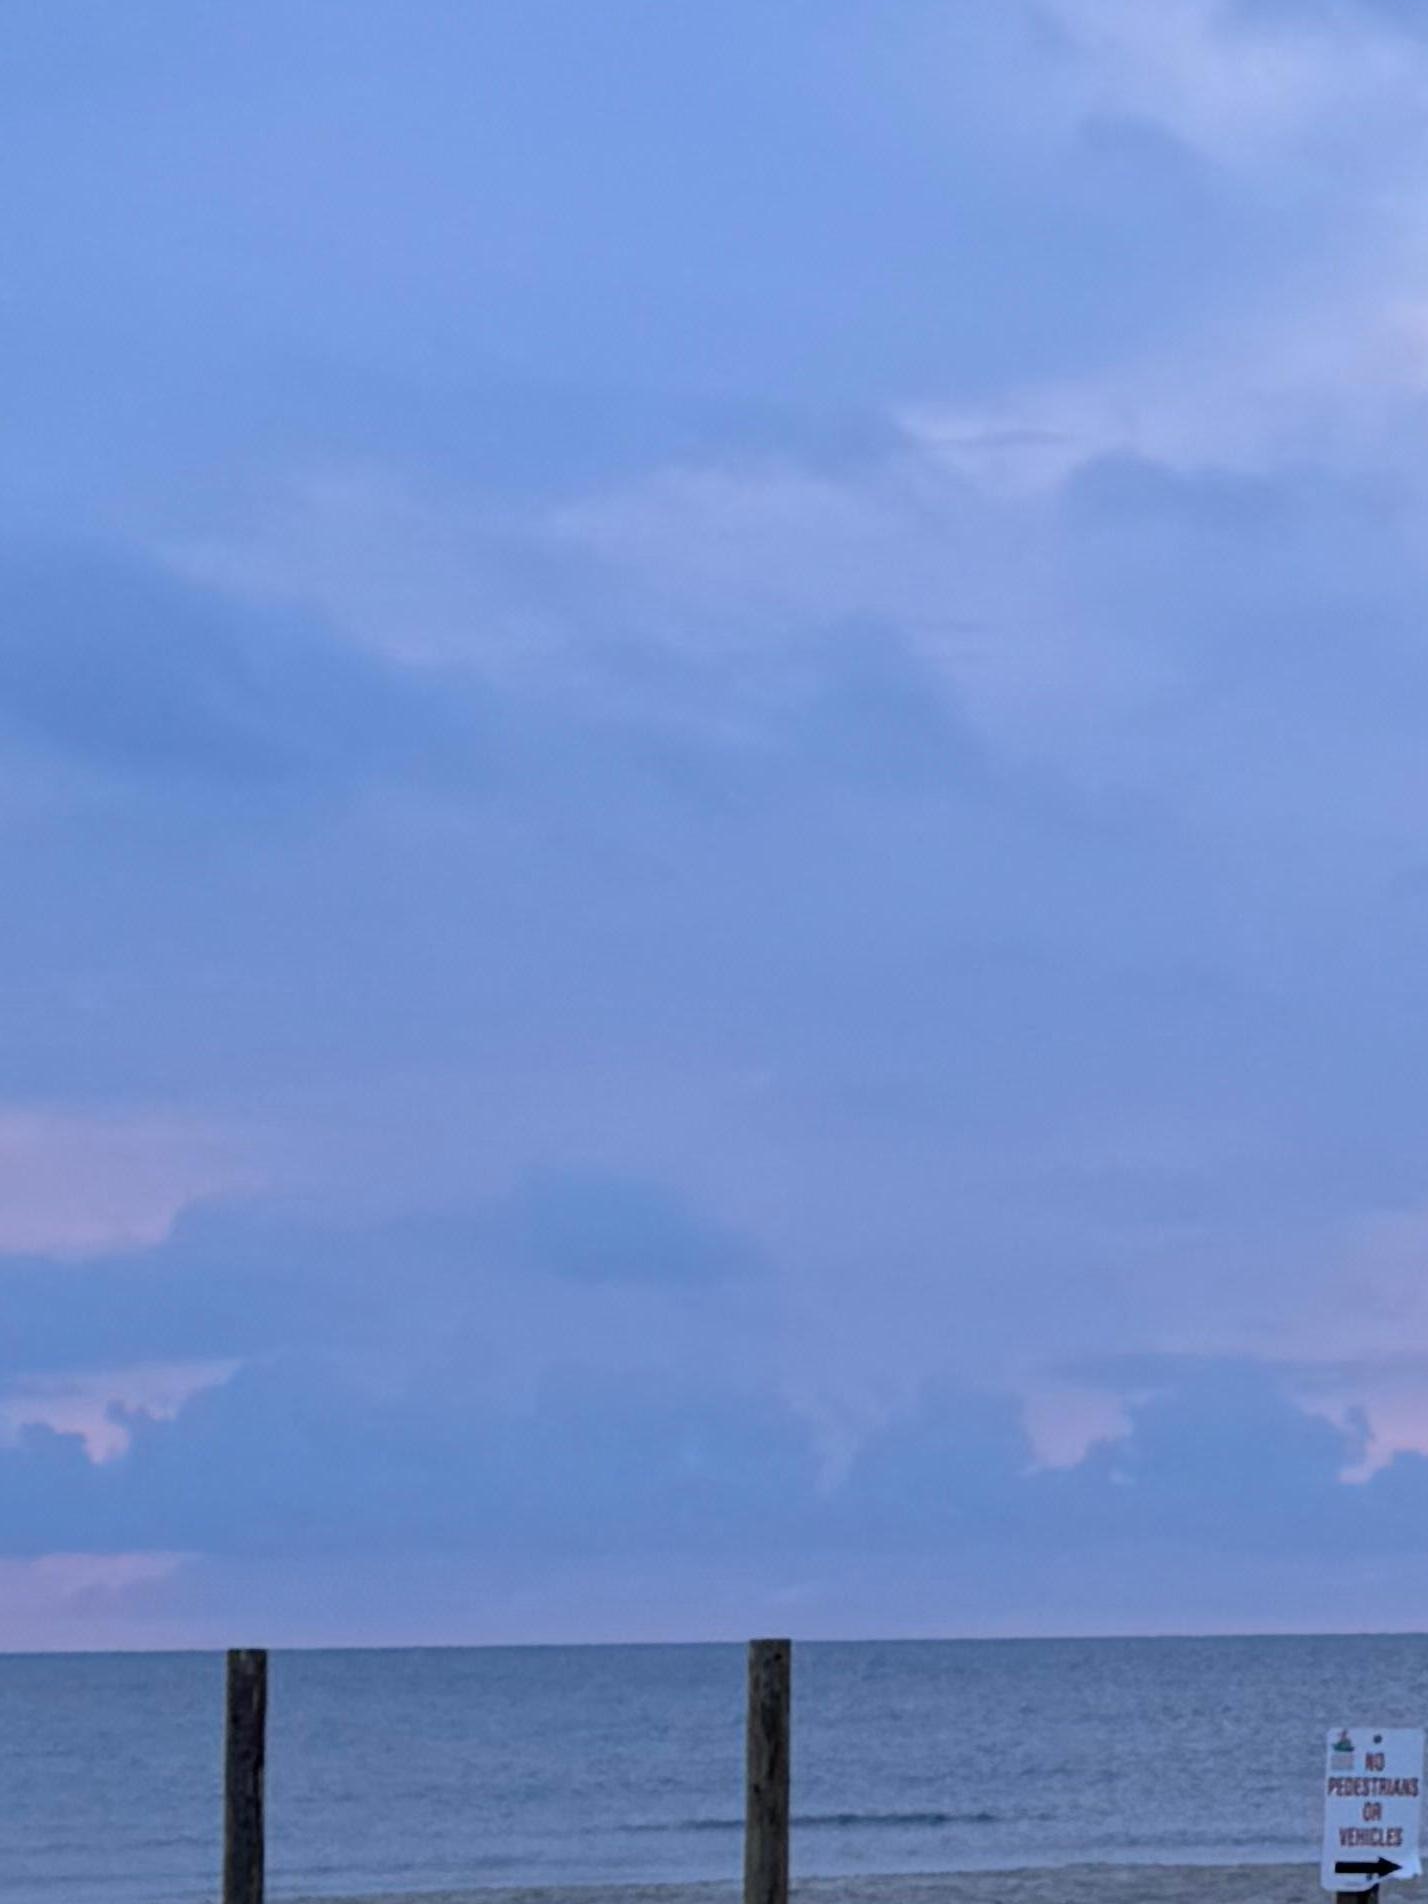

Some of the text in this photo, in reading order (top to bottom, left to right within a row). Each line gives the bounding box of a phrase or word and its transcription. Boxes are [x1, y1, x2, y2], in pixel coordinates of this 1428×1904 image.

[1365, 1752, 1386, 1772] NO
[1327, 1776, 1419, 1797] PEDESTRIANS
[1362, 1801, 1382, 1822] OR
[1338, 1827, 1403, 1847] VEHICLES
